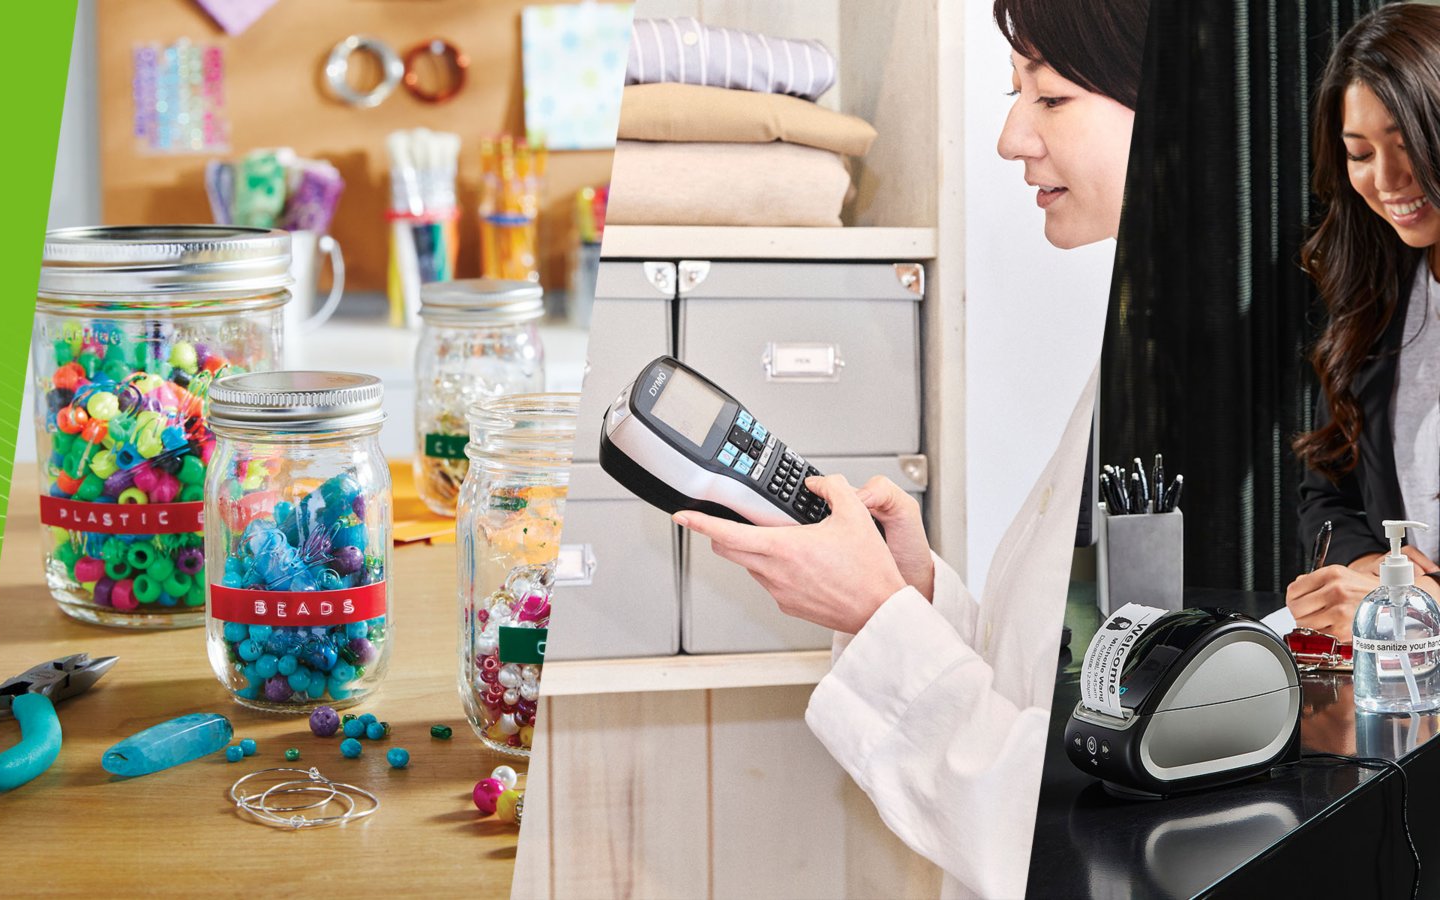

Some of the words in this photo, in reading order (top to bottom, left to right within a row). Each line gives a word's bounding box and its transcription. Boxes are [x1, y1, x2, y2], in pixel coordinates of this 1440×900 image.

[648, 371, 667, 397] DYMO
[59, 508, 169, 527] PLASTIC
[254, 598, 356, 618] BEADS
[1100, 636, 1119, 673] Michelle
[1356, 640, 1375, 651] Please
[1376, 642, 1408, 652] sanitize
[1409, 642, 1427, 652] your
[1109, 623, 1148, 695] Welcome
